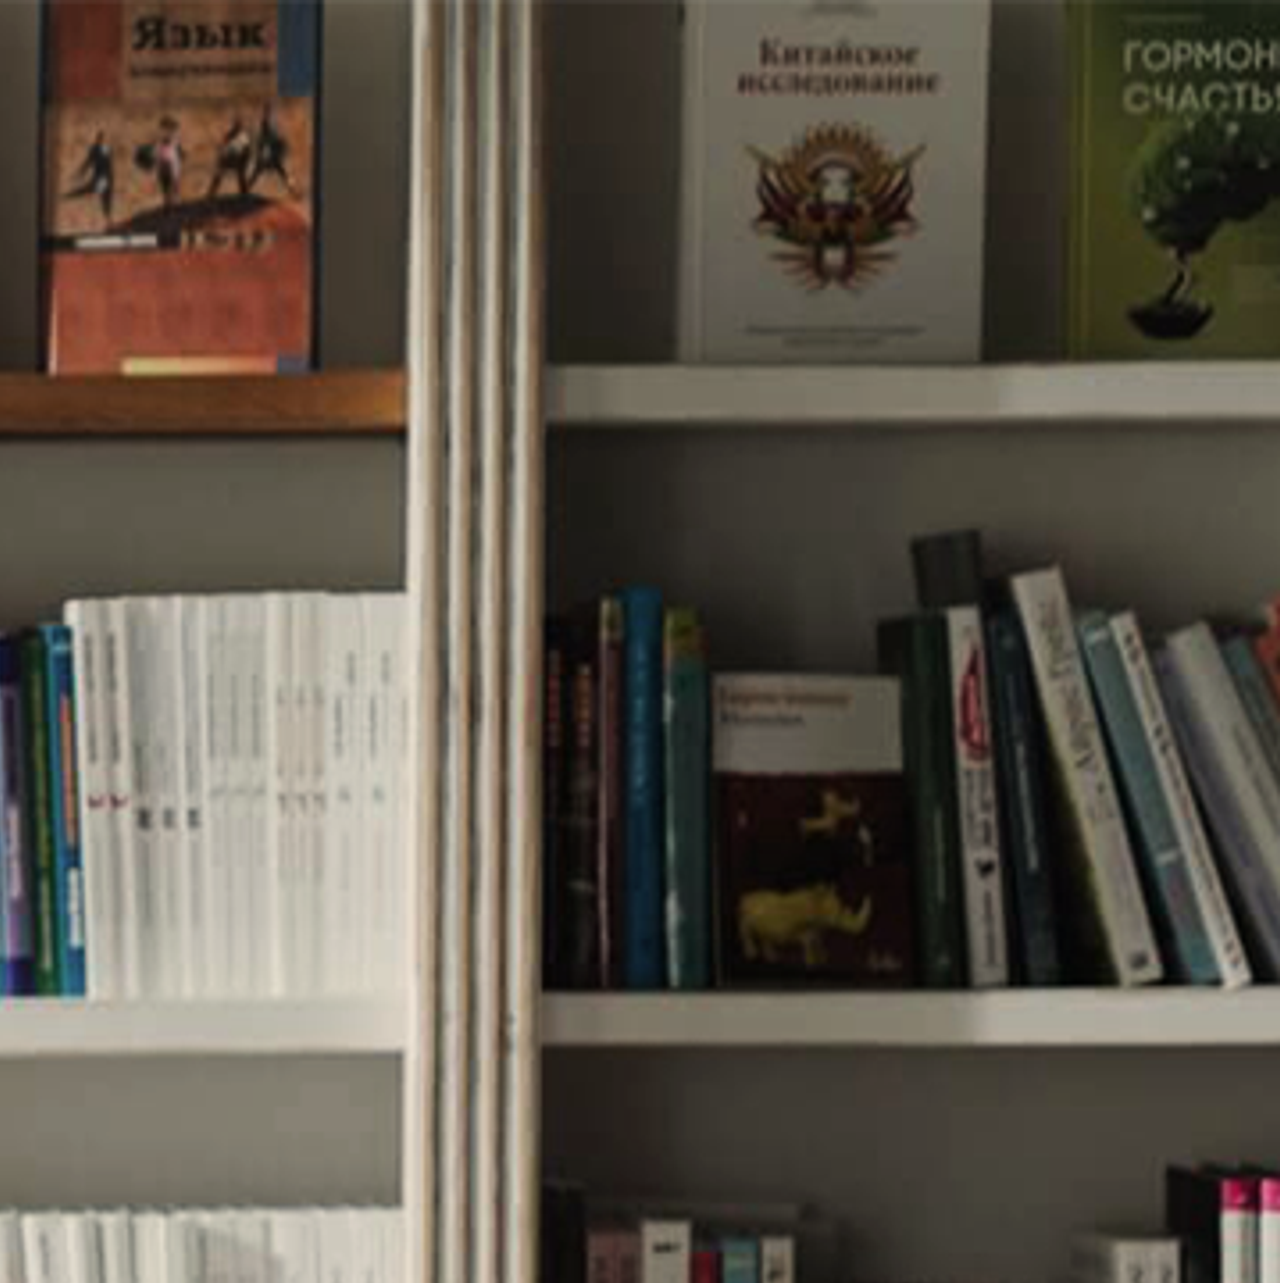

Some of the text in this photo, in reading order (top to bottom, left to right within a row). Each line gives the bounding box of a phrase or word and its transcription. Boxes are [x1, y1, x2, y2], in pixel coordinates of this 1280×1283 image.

[131, 16, 266, 51] Язык
[758, 36, 920, 67] Китайское
[1123, 38, 1280, 73] ГОРМОН
[736, 73, 939, 96] исследование
[1122, 81, 1280, 114] СЧАСТЬ
